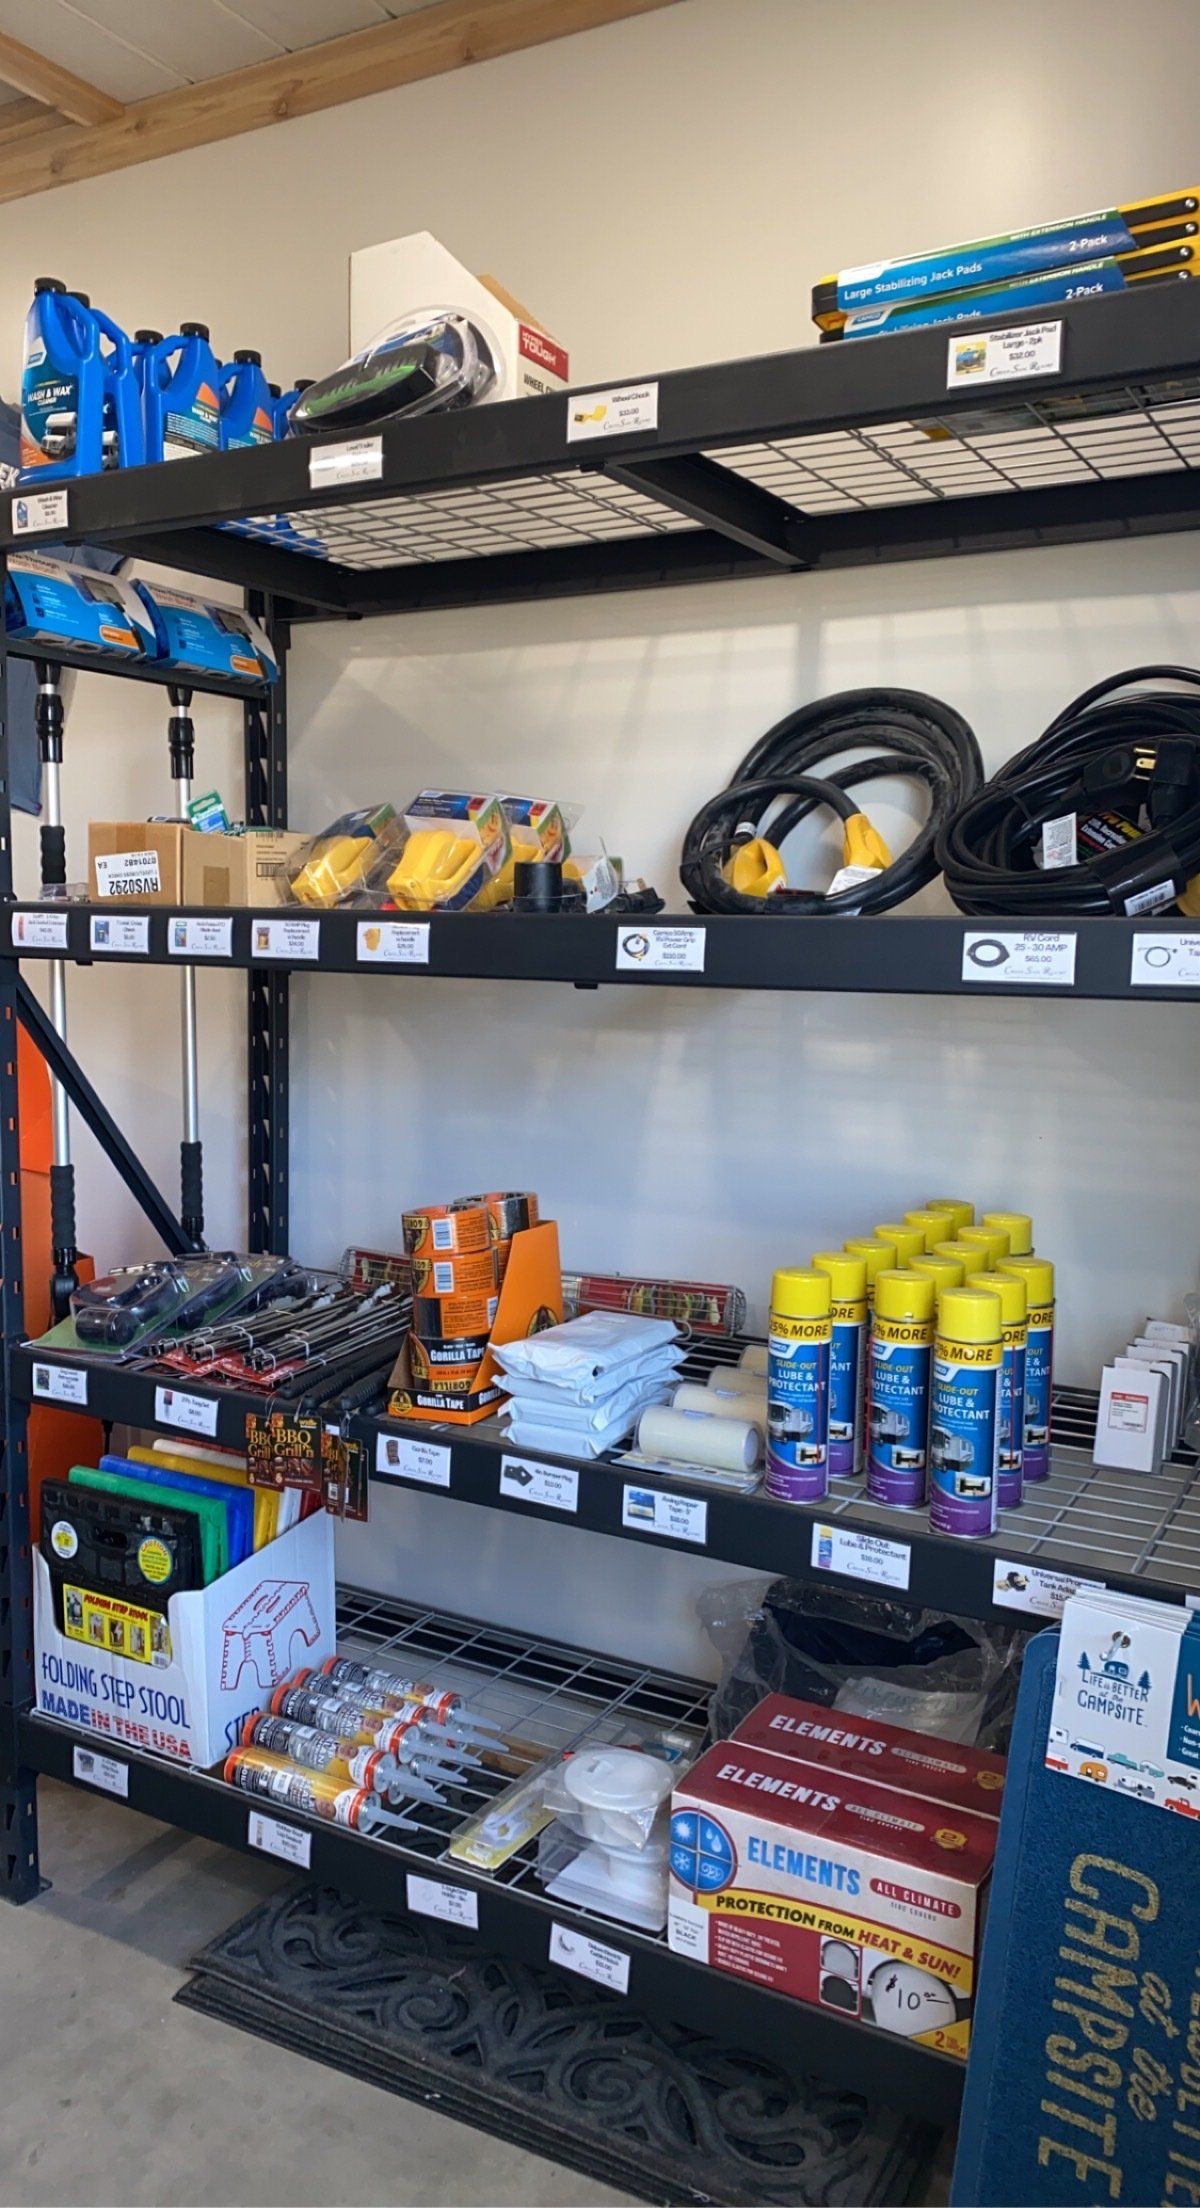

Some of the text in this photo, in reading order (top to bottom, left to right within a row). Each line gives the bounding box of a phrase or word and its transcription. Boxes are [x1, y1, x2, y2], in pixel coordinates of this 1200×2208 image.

[1069, 235, 1108, 251] 2-Pack
[844, 262, 983, 301] Large Stabilizing Jack Pads
[1066, 283, 1104, 299] 2-Pack
[1042, 325, 1057, 334] Pad
[1003, 341, 1025, 350] Large
[524, 373, 544, 393] WHEEL
[28, 389, 46, 402] WASH
[53, 385, 72, 397] WAX
[98, 861, 108, 869] EA
[109, 877, 159, 895] RVS0292
[1037, 933, 1060, 942] Cord
[1033, 943, 1044, 951] 30
[1044, 943, 1068, 952] AMP
[790, 1324, 828, 1337] MORE
[887, 1327, 928, 1341] MORE
[1003, 1329, 1025, 1343] ORE
[431, 1348, 466, 1361] GORILLA
[950, 1347, 993, 1361] MORE
[776, 1358, 817, 1369] SLIDE-OUT
[778, 1370, 814, 1381] LUBE &
[876, 1371, 910, 1384] LUBE &
[769, 1376, 826, 1392] PROTECTANT
[417, 1394, 465, 1410] GORILLA TAPE
[939, 1393, 975, 1408] LUBE &
[276, 1429, 312, 1449] BBQ
[274, 1443, 315, 1459] Grill'n
[840, 1538, 858, 1547] Lube
[865, 1544, 907, 1560] Protectant
[1040, 1580, 1057, 1590] Tank
[84, 1594, 149, 1622] FOLDING STEP STOOL
[42, 1652, 191, 1729] FOLDING STEP STOOL
[1081, 1670, 1104, 1690] LIFE
[1112, 1680, 1149, 1703] BETTER
[1077, 1689, 1145, 1727] CAMPSITE
[42, 1690, 193, 1760] MADE IN THE USA
[769, 1714, 887, 1757] ELEMENTS
[716, 1764, 841, 1812] ELEMENTS
[852, 1805, 917, 1829] ALL CLIMATE
[748, 1836, 860, 1896] ELEMENTS
[877, 1882, 954, 1915] ALL CLIMATE
[716, 1895, 816, 1926] PROTECTION
[818, 1919, 855, 1939] FROM
[858, 1929, 901, 1956] HEAT
[904, 1946, 914, 1958] &
[917, 1952, 961, 1978] SUN!
[1038, 1853, 1160, 2200] CAMPSITE
[935, 2031, 945, 2048] 2
